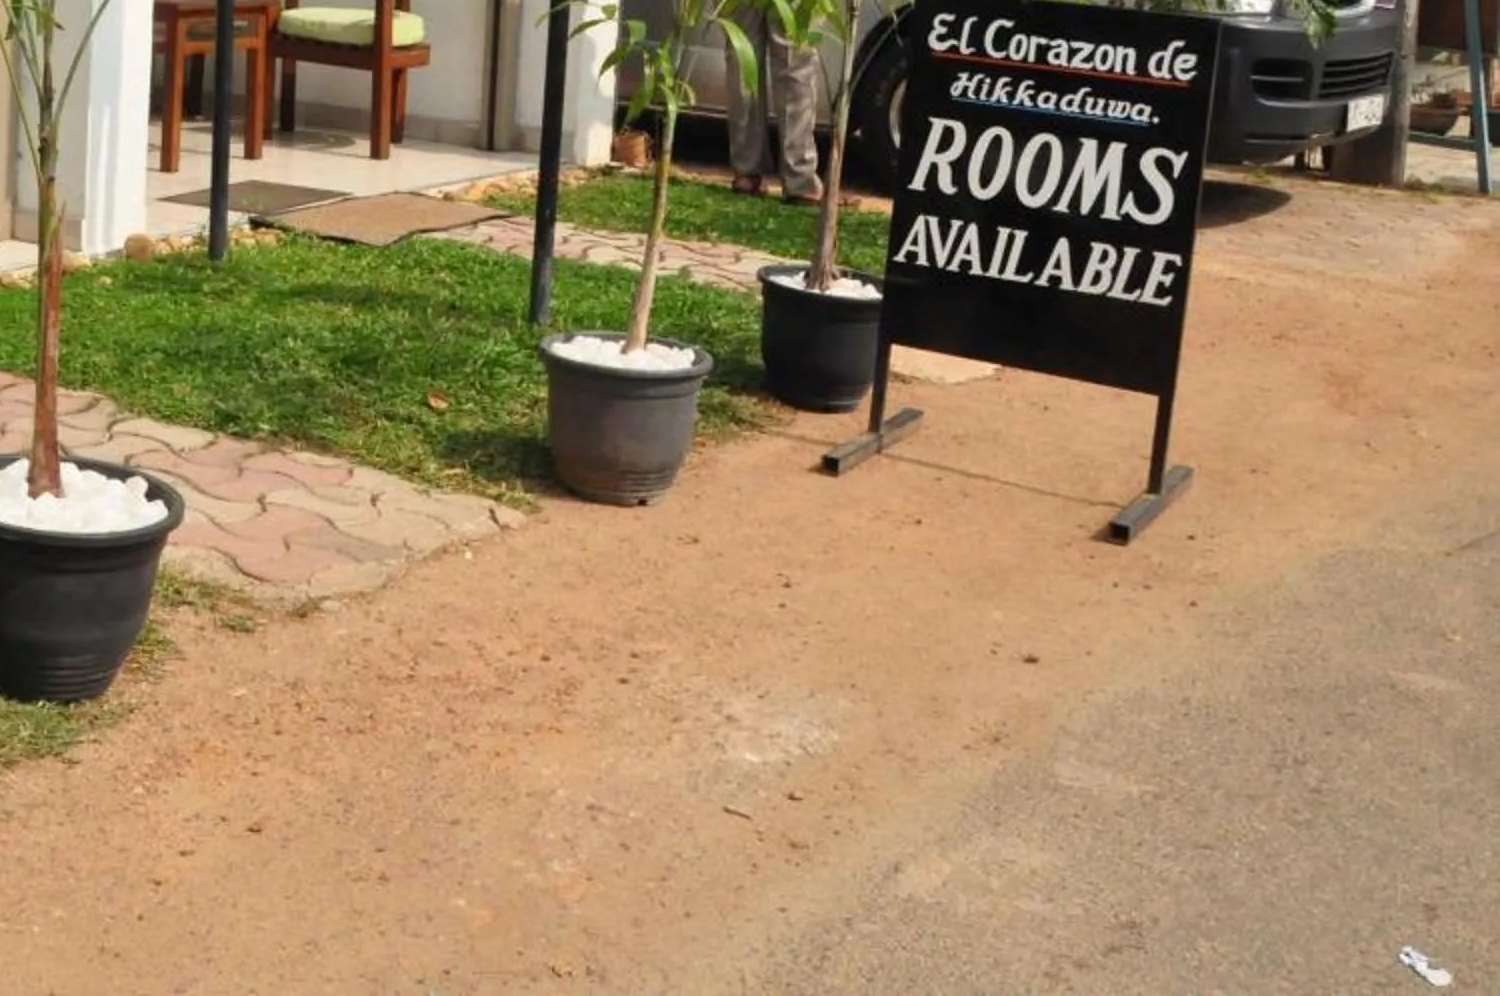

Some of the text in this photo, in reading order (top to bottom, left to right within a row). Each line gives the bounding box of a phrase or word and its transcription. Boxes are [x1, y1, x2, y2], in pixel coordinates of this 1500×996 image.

[927, 12, 1199, 82] El Corazon de
[950, 71, 1161, 124] Hikkaduwa.
[908, 115, 1189, 226] ROOMS
[893, 213, 1183, 307] AVAILABLE
